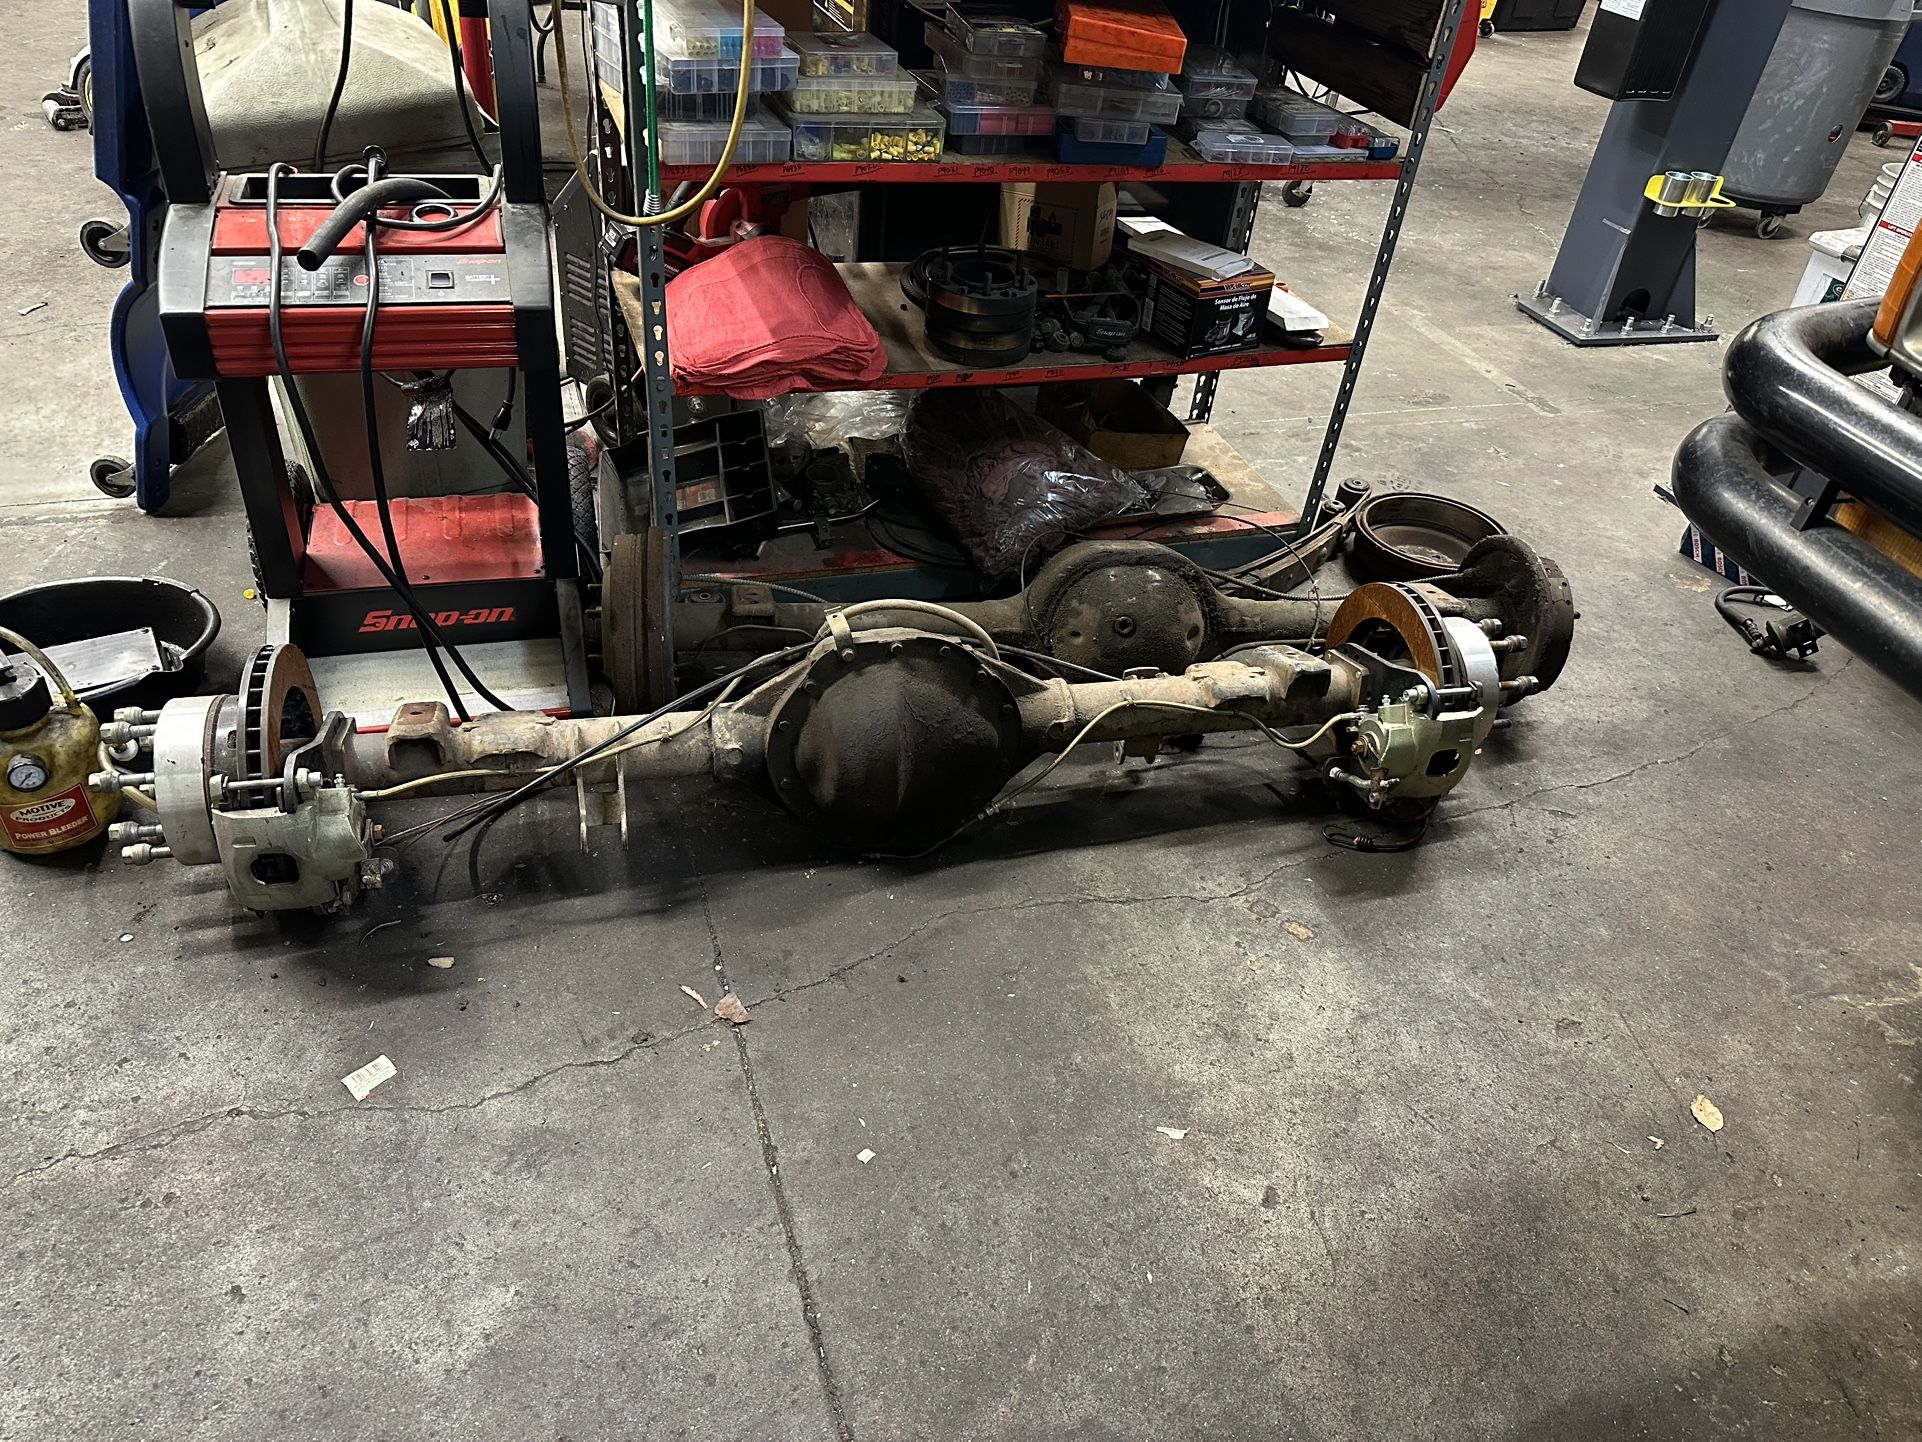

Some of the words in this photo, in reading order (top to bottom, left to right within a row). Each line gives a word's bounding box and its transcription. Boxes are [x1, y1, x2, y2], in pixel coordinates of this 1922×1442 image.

[359, 607, 515, 632] Snp-on
[16, 804, 72, 822] PRODUCTS
[19, 800, 65, 816] MOTIVE
[15, 831, 48, 840] POWER
[48, 816, 88, 835] BLEEDER
